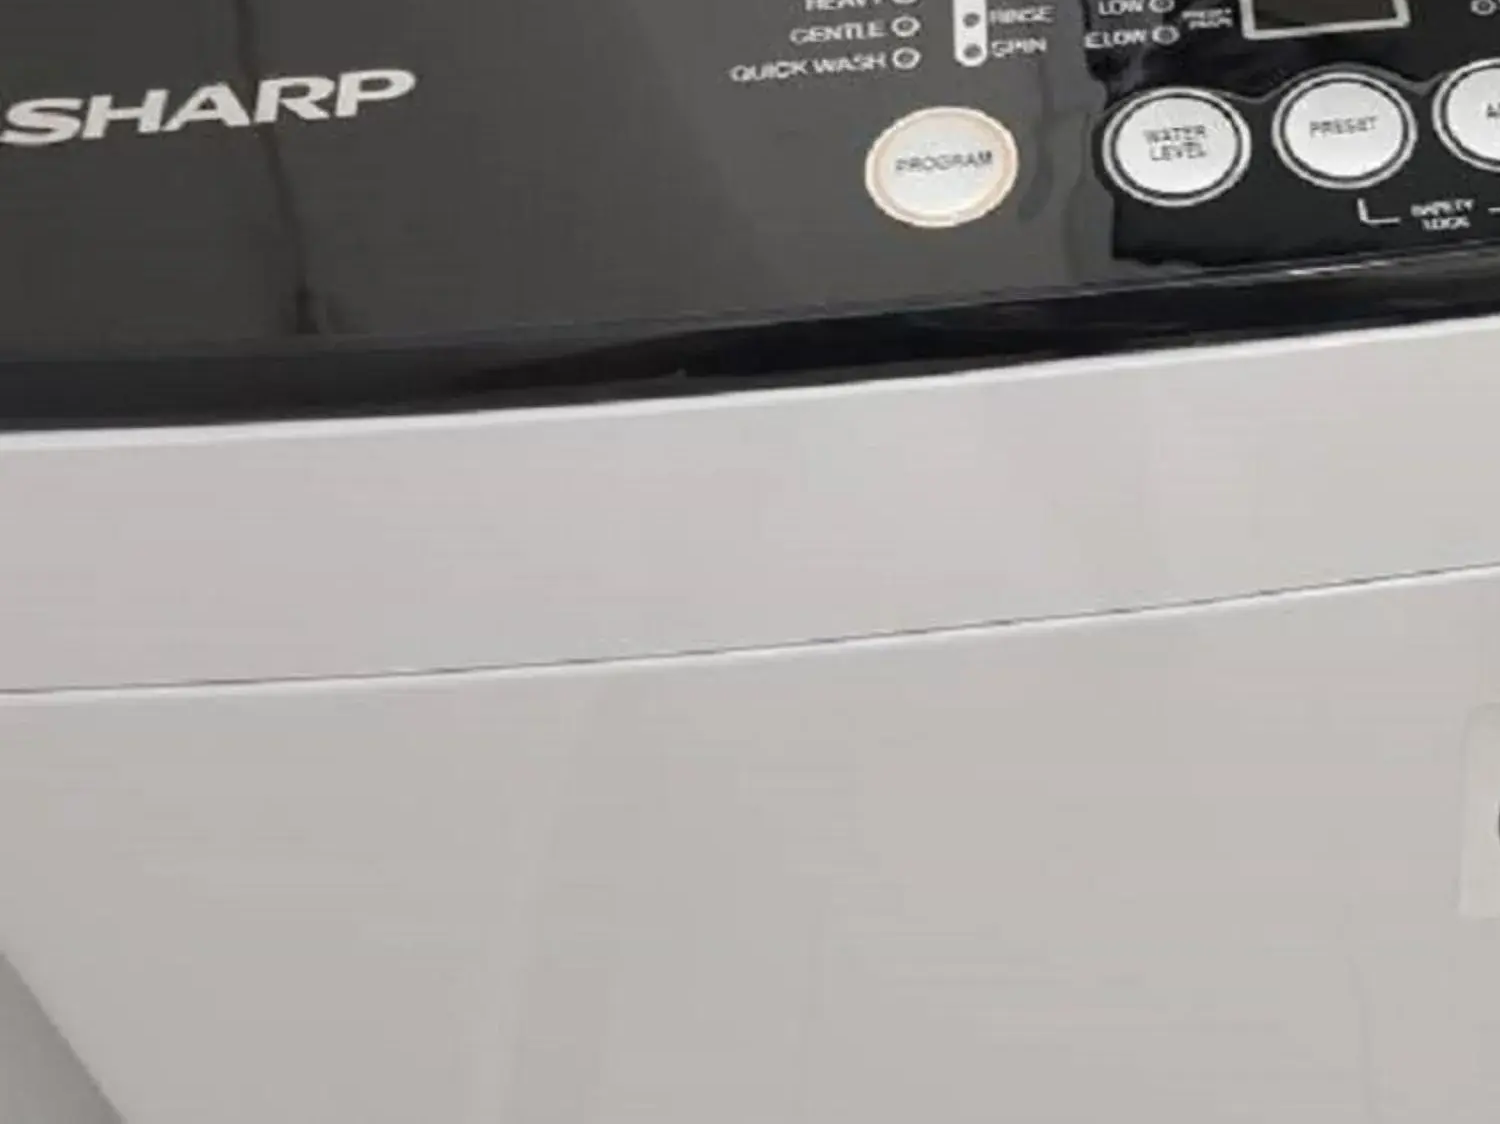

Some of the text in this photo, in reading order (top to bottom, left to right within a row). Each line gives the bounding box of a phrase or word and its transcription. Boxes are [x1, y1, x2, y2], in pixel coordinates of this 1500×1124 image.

[788, 20, 887, 46] GENTLE
[991, 37, 1048, 57] SPIN
[729, 51, 887, 82] QUICK WASH
[0, 68, 417, 146] SHARP
[1142, 124, 1207, 144] WATER
[1309, 116, 1379, 138] PRESET
[895, 150, 993, 172] PROGRAM
